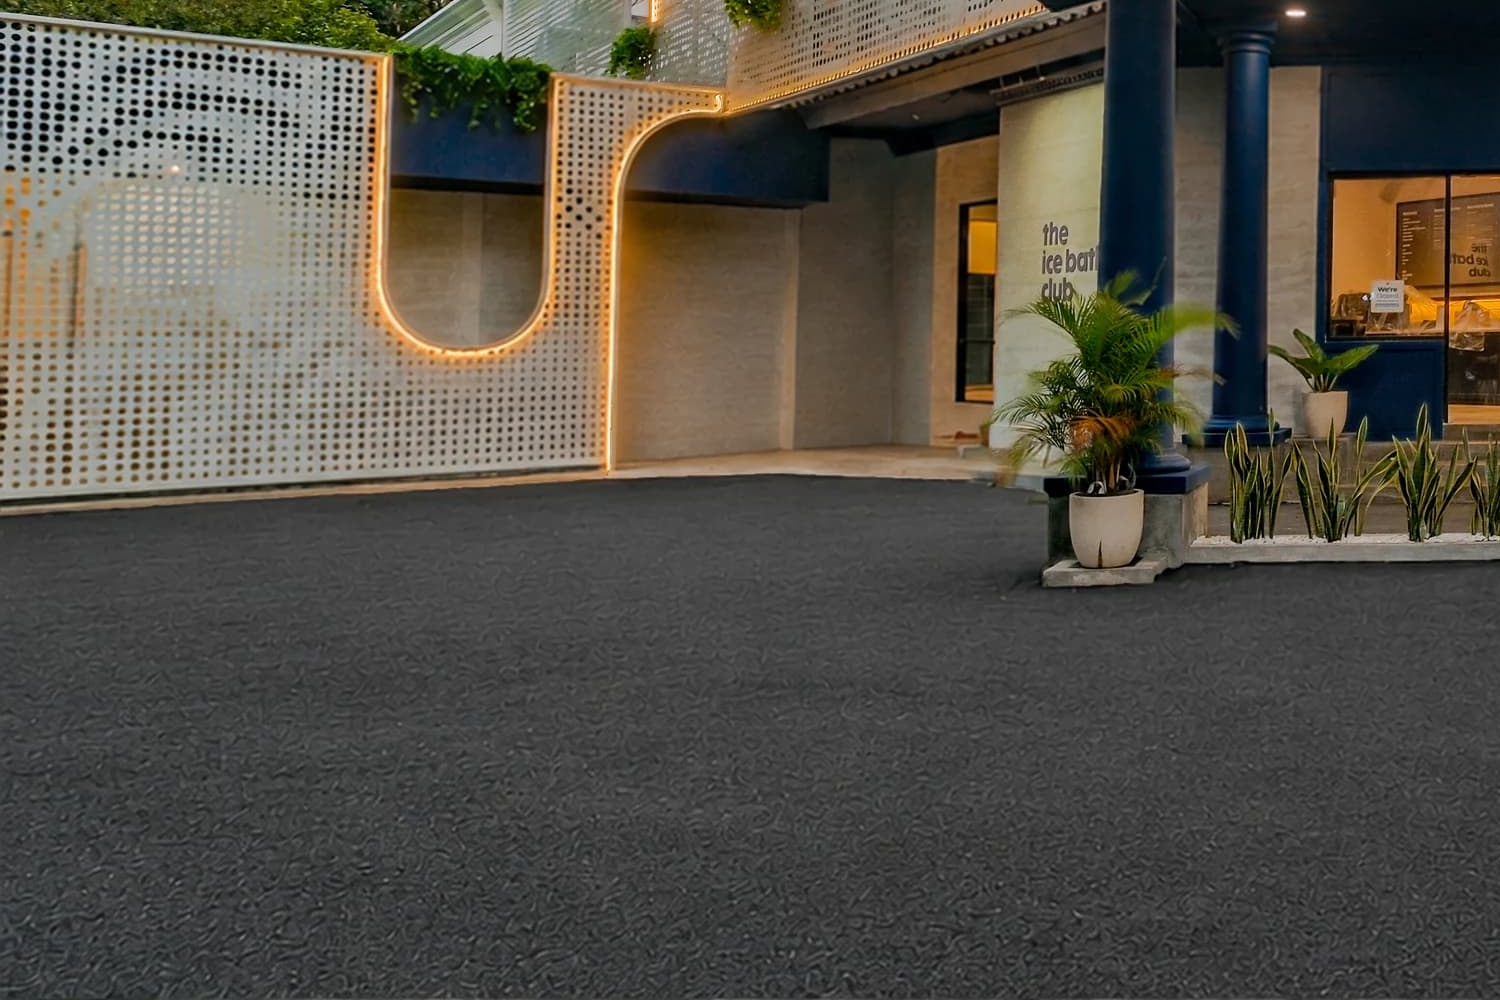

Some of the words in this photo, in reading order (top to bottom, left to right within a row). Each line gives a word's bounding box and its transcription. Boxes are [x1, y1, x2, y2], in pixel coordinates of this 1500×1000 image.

[1042, 221, 1069, 246] the
[1042, 250, 1063, 274] ice
[1041, 277, 1073, 301] club
